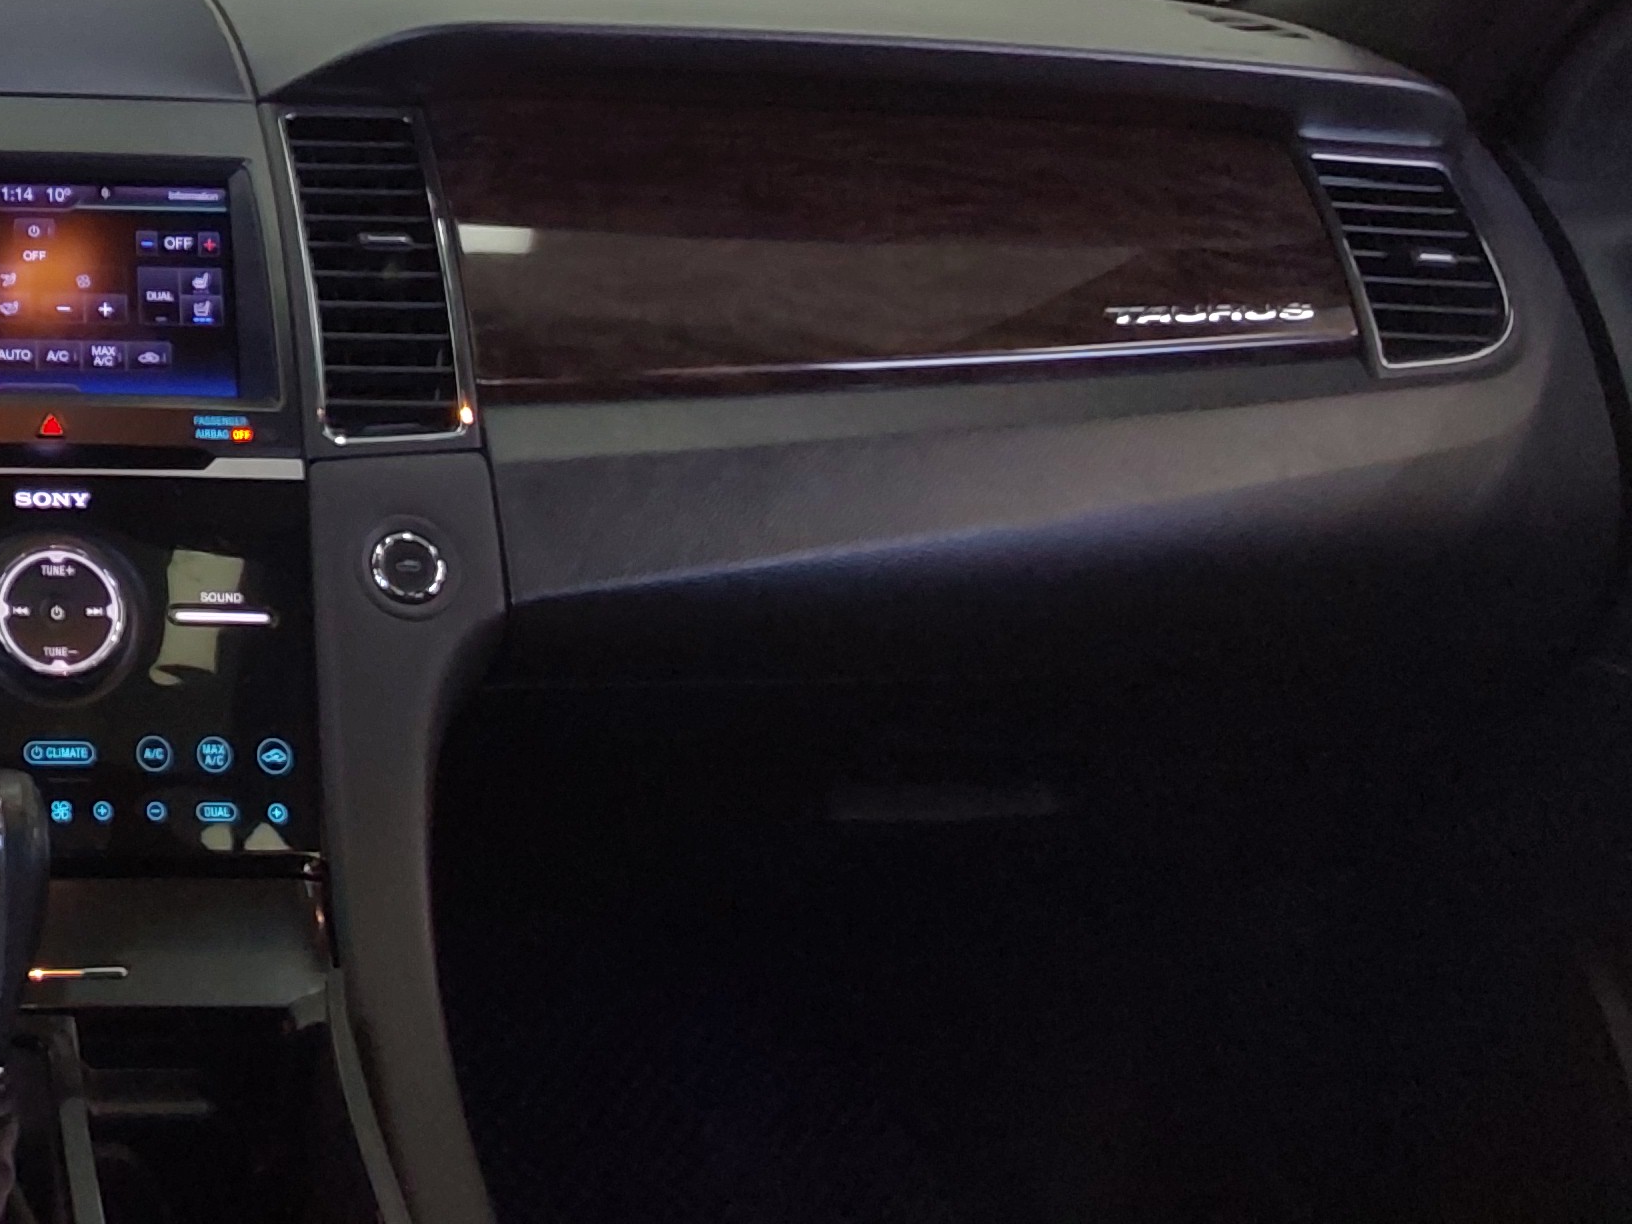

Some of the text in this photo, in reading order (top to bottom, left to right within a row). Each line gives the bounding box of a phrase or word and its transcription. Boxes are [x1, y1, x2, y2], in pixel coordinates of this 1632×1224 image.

[1, 186, 33, 202] 1:14
[163, 236, 194, 251] OFF
[23, 250, 47, 262] OFF
[145, 290, 175, 303] DUAL
[45, 349, 69, 363] A/C
[91, 345, 116, 356] MAX
[93, 355, 114, 367] A/C
[195, 427, 253, 441] AIRBAG OFF
[14, 491, 91, 510] SONY
[200, 590, 244, 604] SOUND
[45, 747, 88, 759] CLIMATE
[143, 747, 164, 760] A/C
[202, 744, 226, 755] MAX
[204, 755, 225, 766] A/C
[204, 807, 231, 818] DUAL
